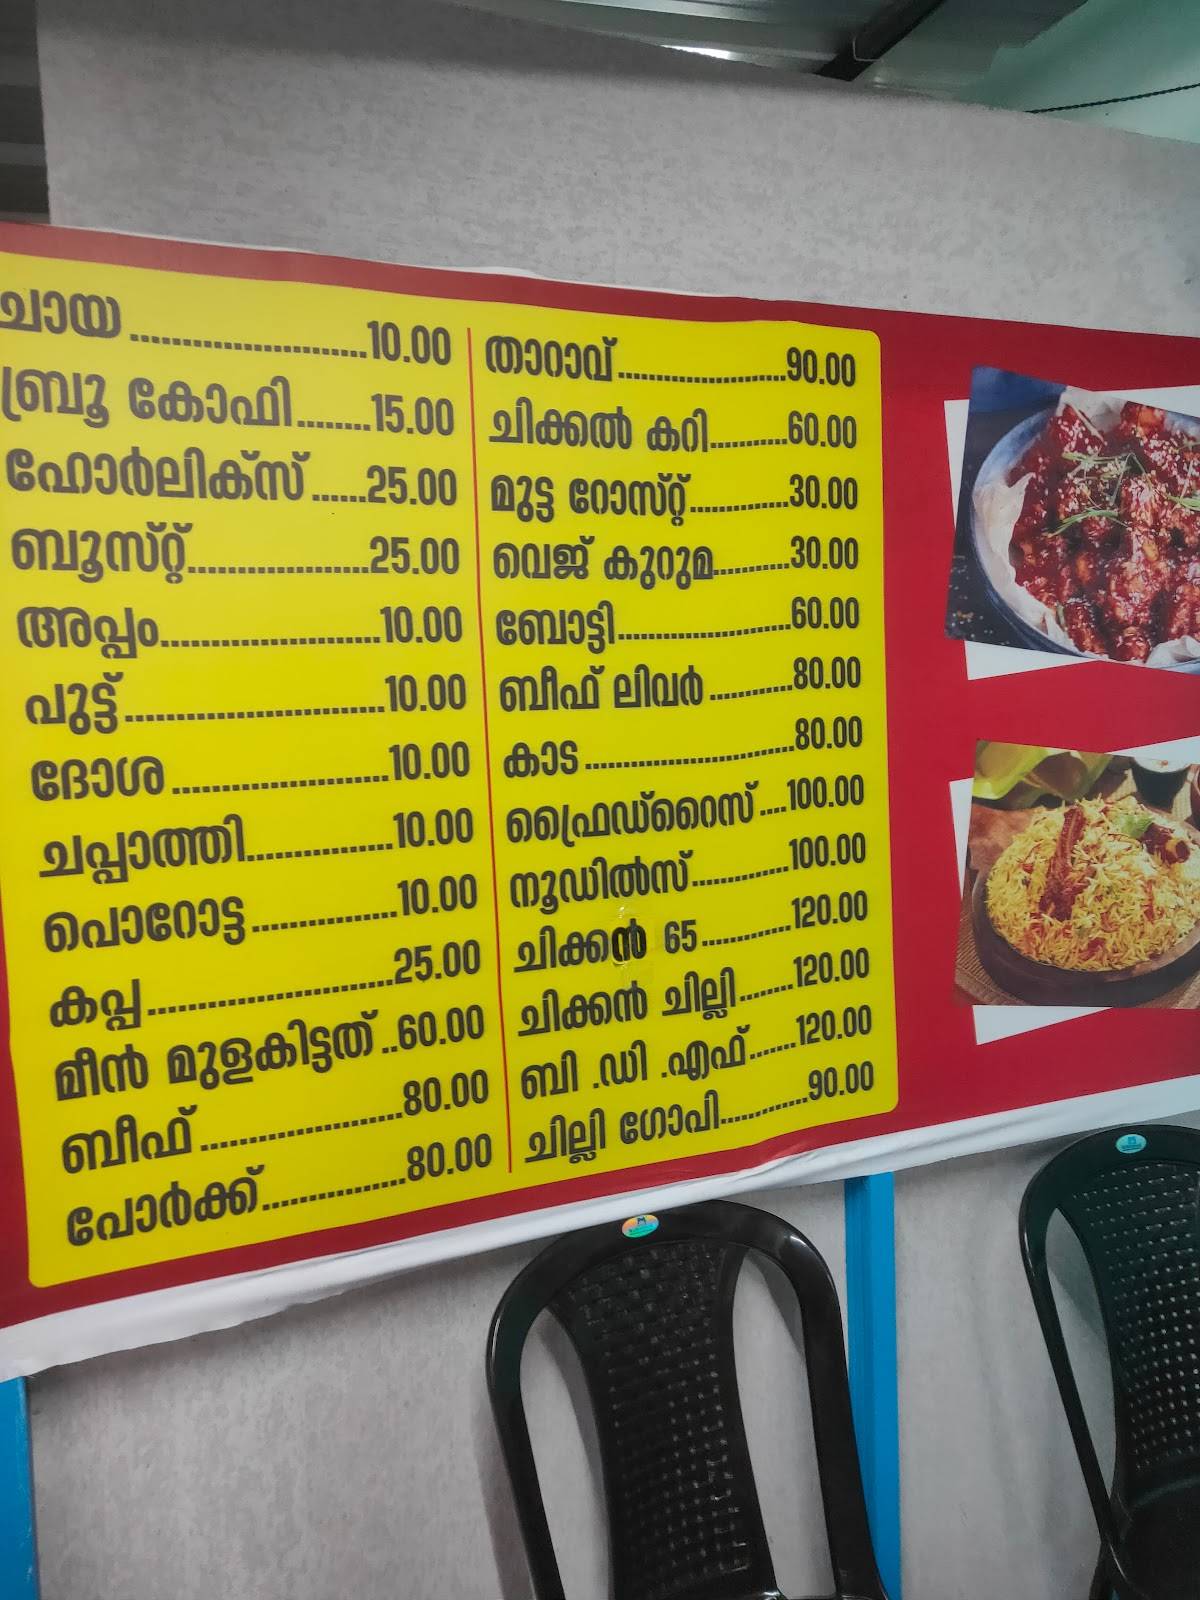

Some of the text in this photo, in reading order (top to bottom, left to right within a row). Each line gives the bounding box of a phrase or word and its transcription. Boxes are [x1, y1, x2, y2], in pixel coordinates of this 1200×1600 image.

[368, 320, 451, 366] 10.00
[787, 346, 856, 388] 90.00
[371, 393, 455, 437] 15.00
[788, 410, 857, 449] 60.00
[367, 464, 457, 506] 25.00
[788, 473, 858, 510] 30.00
[369, 535, 460, 575] 25.00
[790, 535, 859, 570] 30.00
[380, 605, 463, 645] 10.00
[791, 596, 860, 631] 60.00
[384, 673, 467, 713] 10.00
[793, 655, 862, 691] 80.00
[795, 715, 863, 751] 80.00
[388, 740, 471, 781] 10.00
[786, 774, 865, 811] 100.00
[393, 807, 475, 849] 10.00
[788, 832, 866, 870] 100.00
[397, 873, 479, 916] 10.00
[664, 919, 698, 956] 65
[791, 889, 868, 930] 120.00
[394, 939, 482, 985] 25.00
[793, 947, 870, 988] 120.00
[397, 1004, 485, 1051] 60.00
[795, 1004, 873, 1047] 120.00
[403, 1068, 489, 1117] 80.00
[808, 1060, 875, 1102] 90.00
[406, 1132, 494, 1182] 80.00
